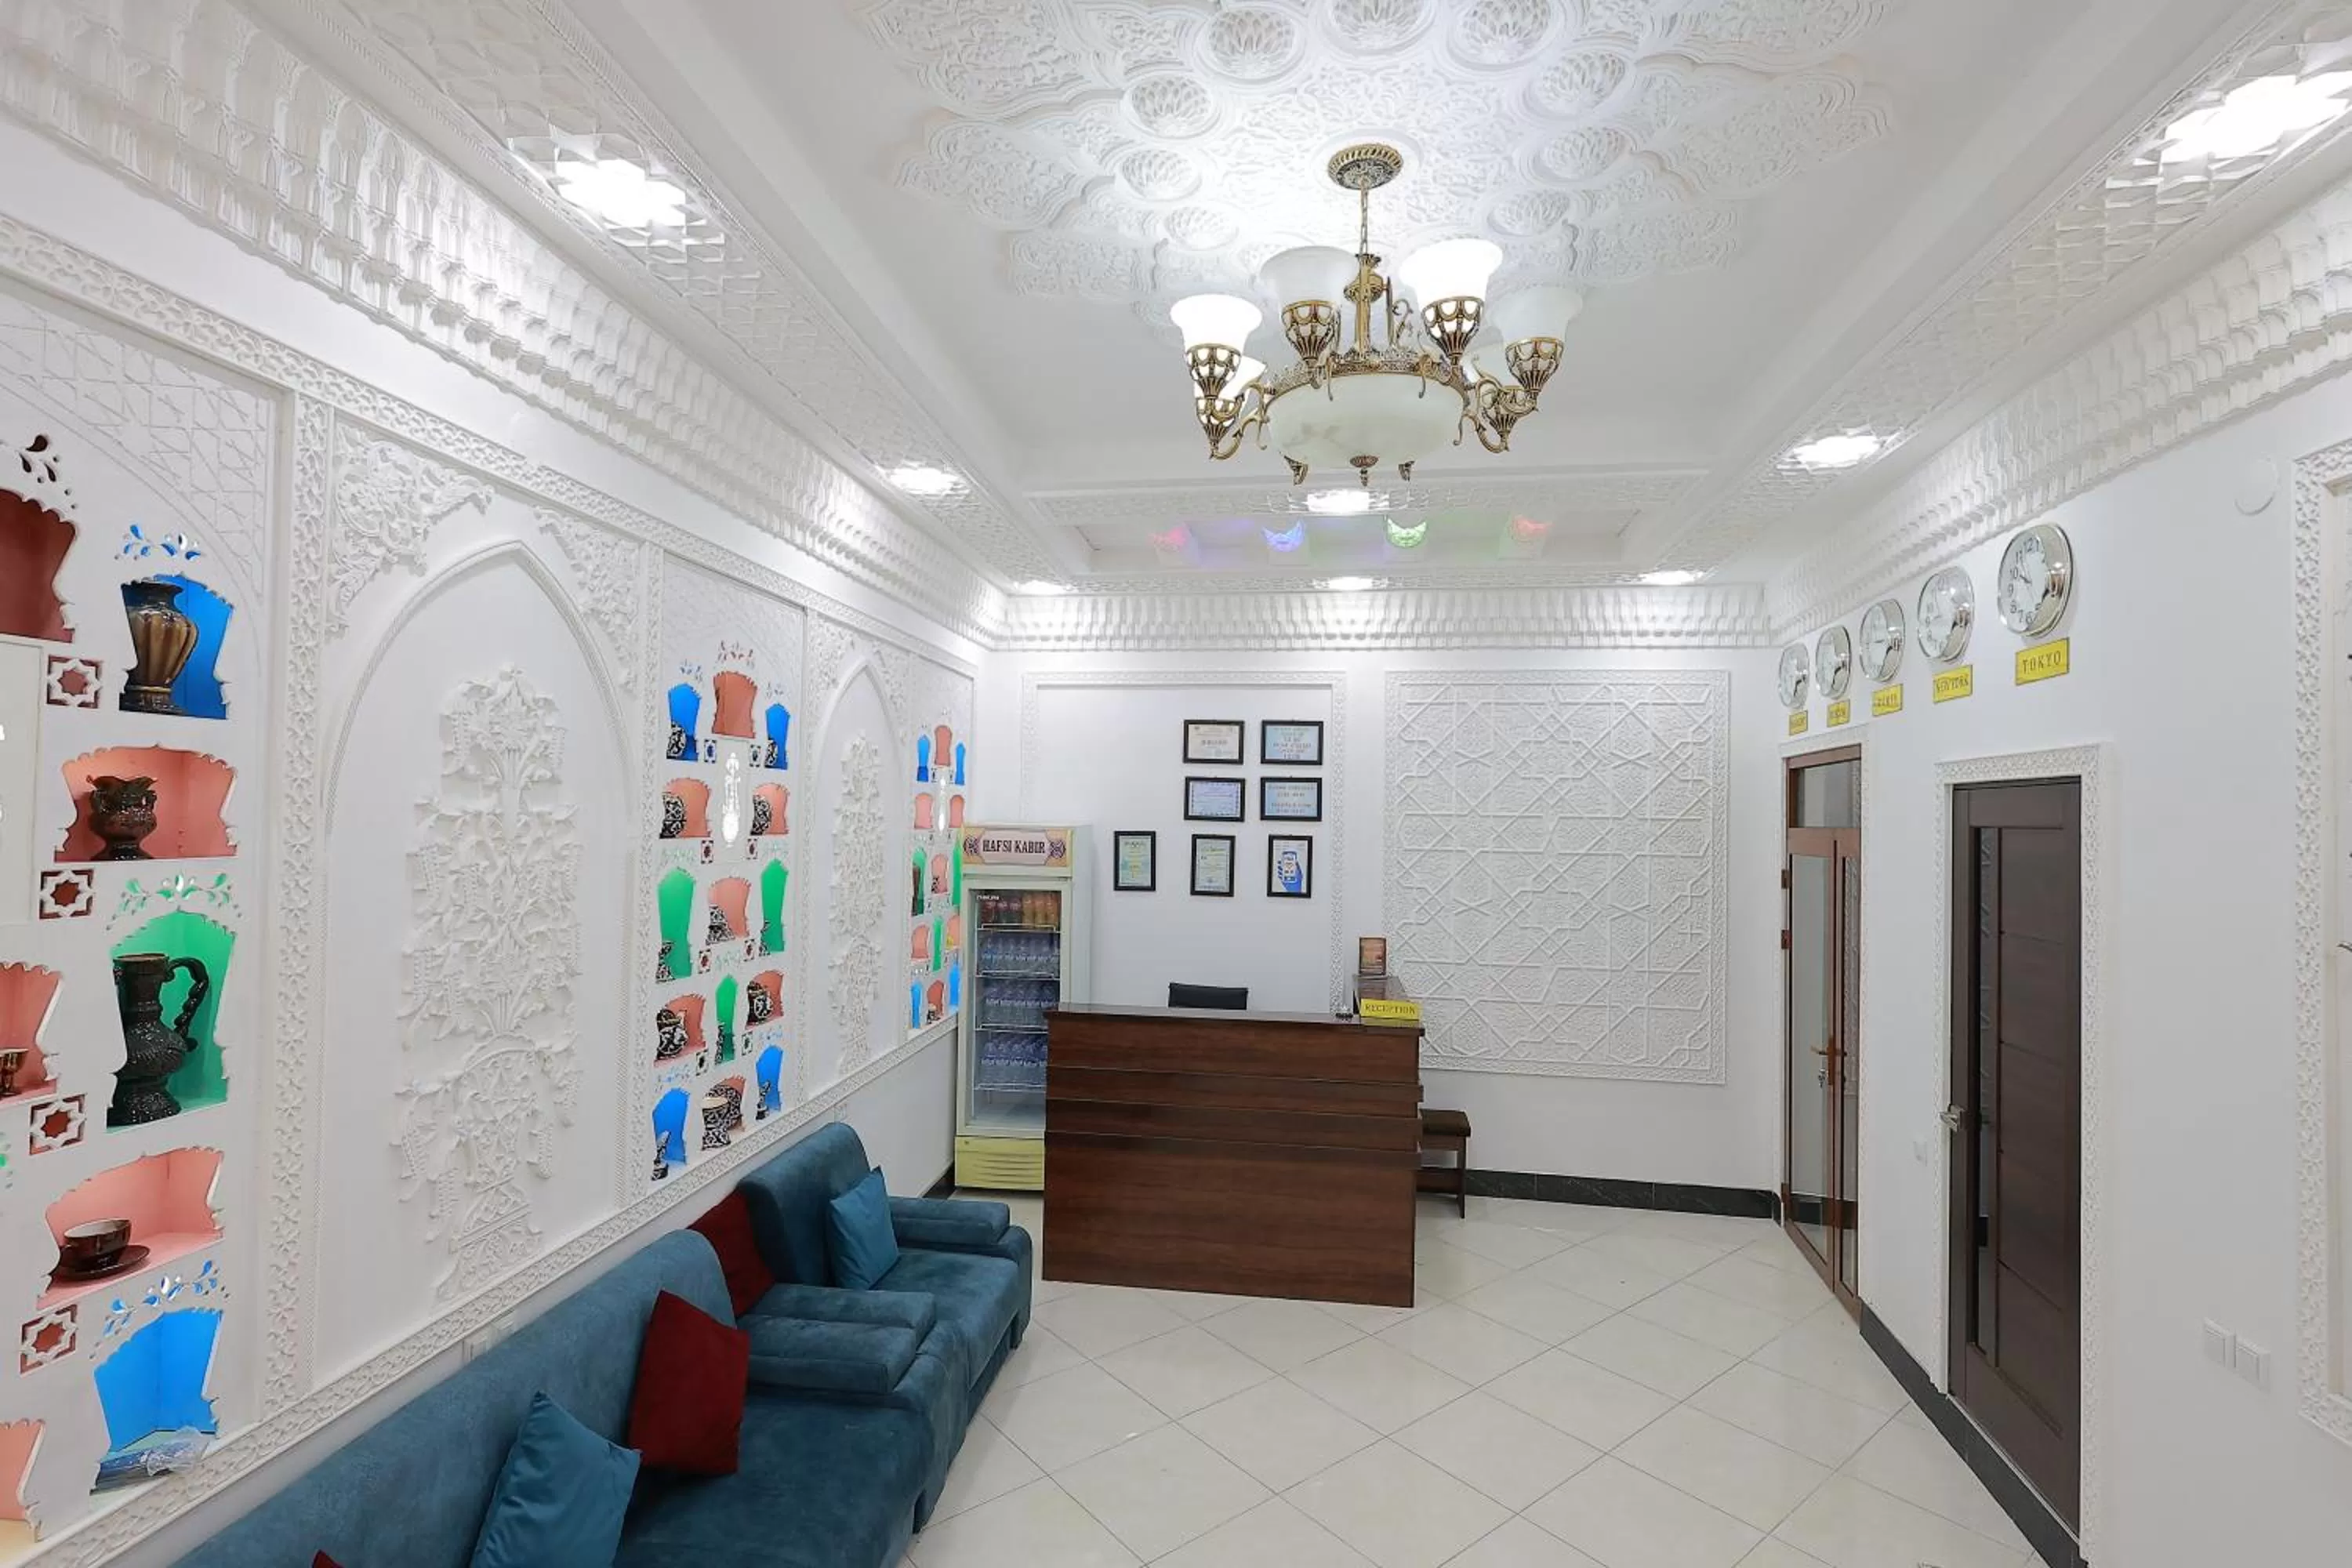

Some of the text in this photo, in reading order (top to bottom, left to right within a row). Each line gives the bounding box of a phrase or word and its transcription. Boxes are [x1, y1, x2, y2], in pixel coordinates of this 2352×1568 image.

[2022, 650, 2062, 674] TOKYO
[982, 840, 1045, 854] HAFSI KABIR
[1365, 1003, 1415, 1014] RECEPTION
